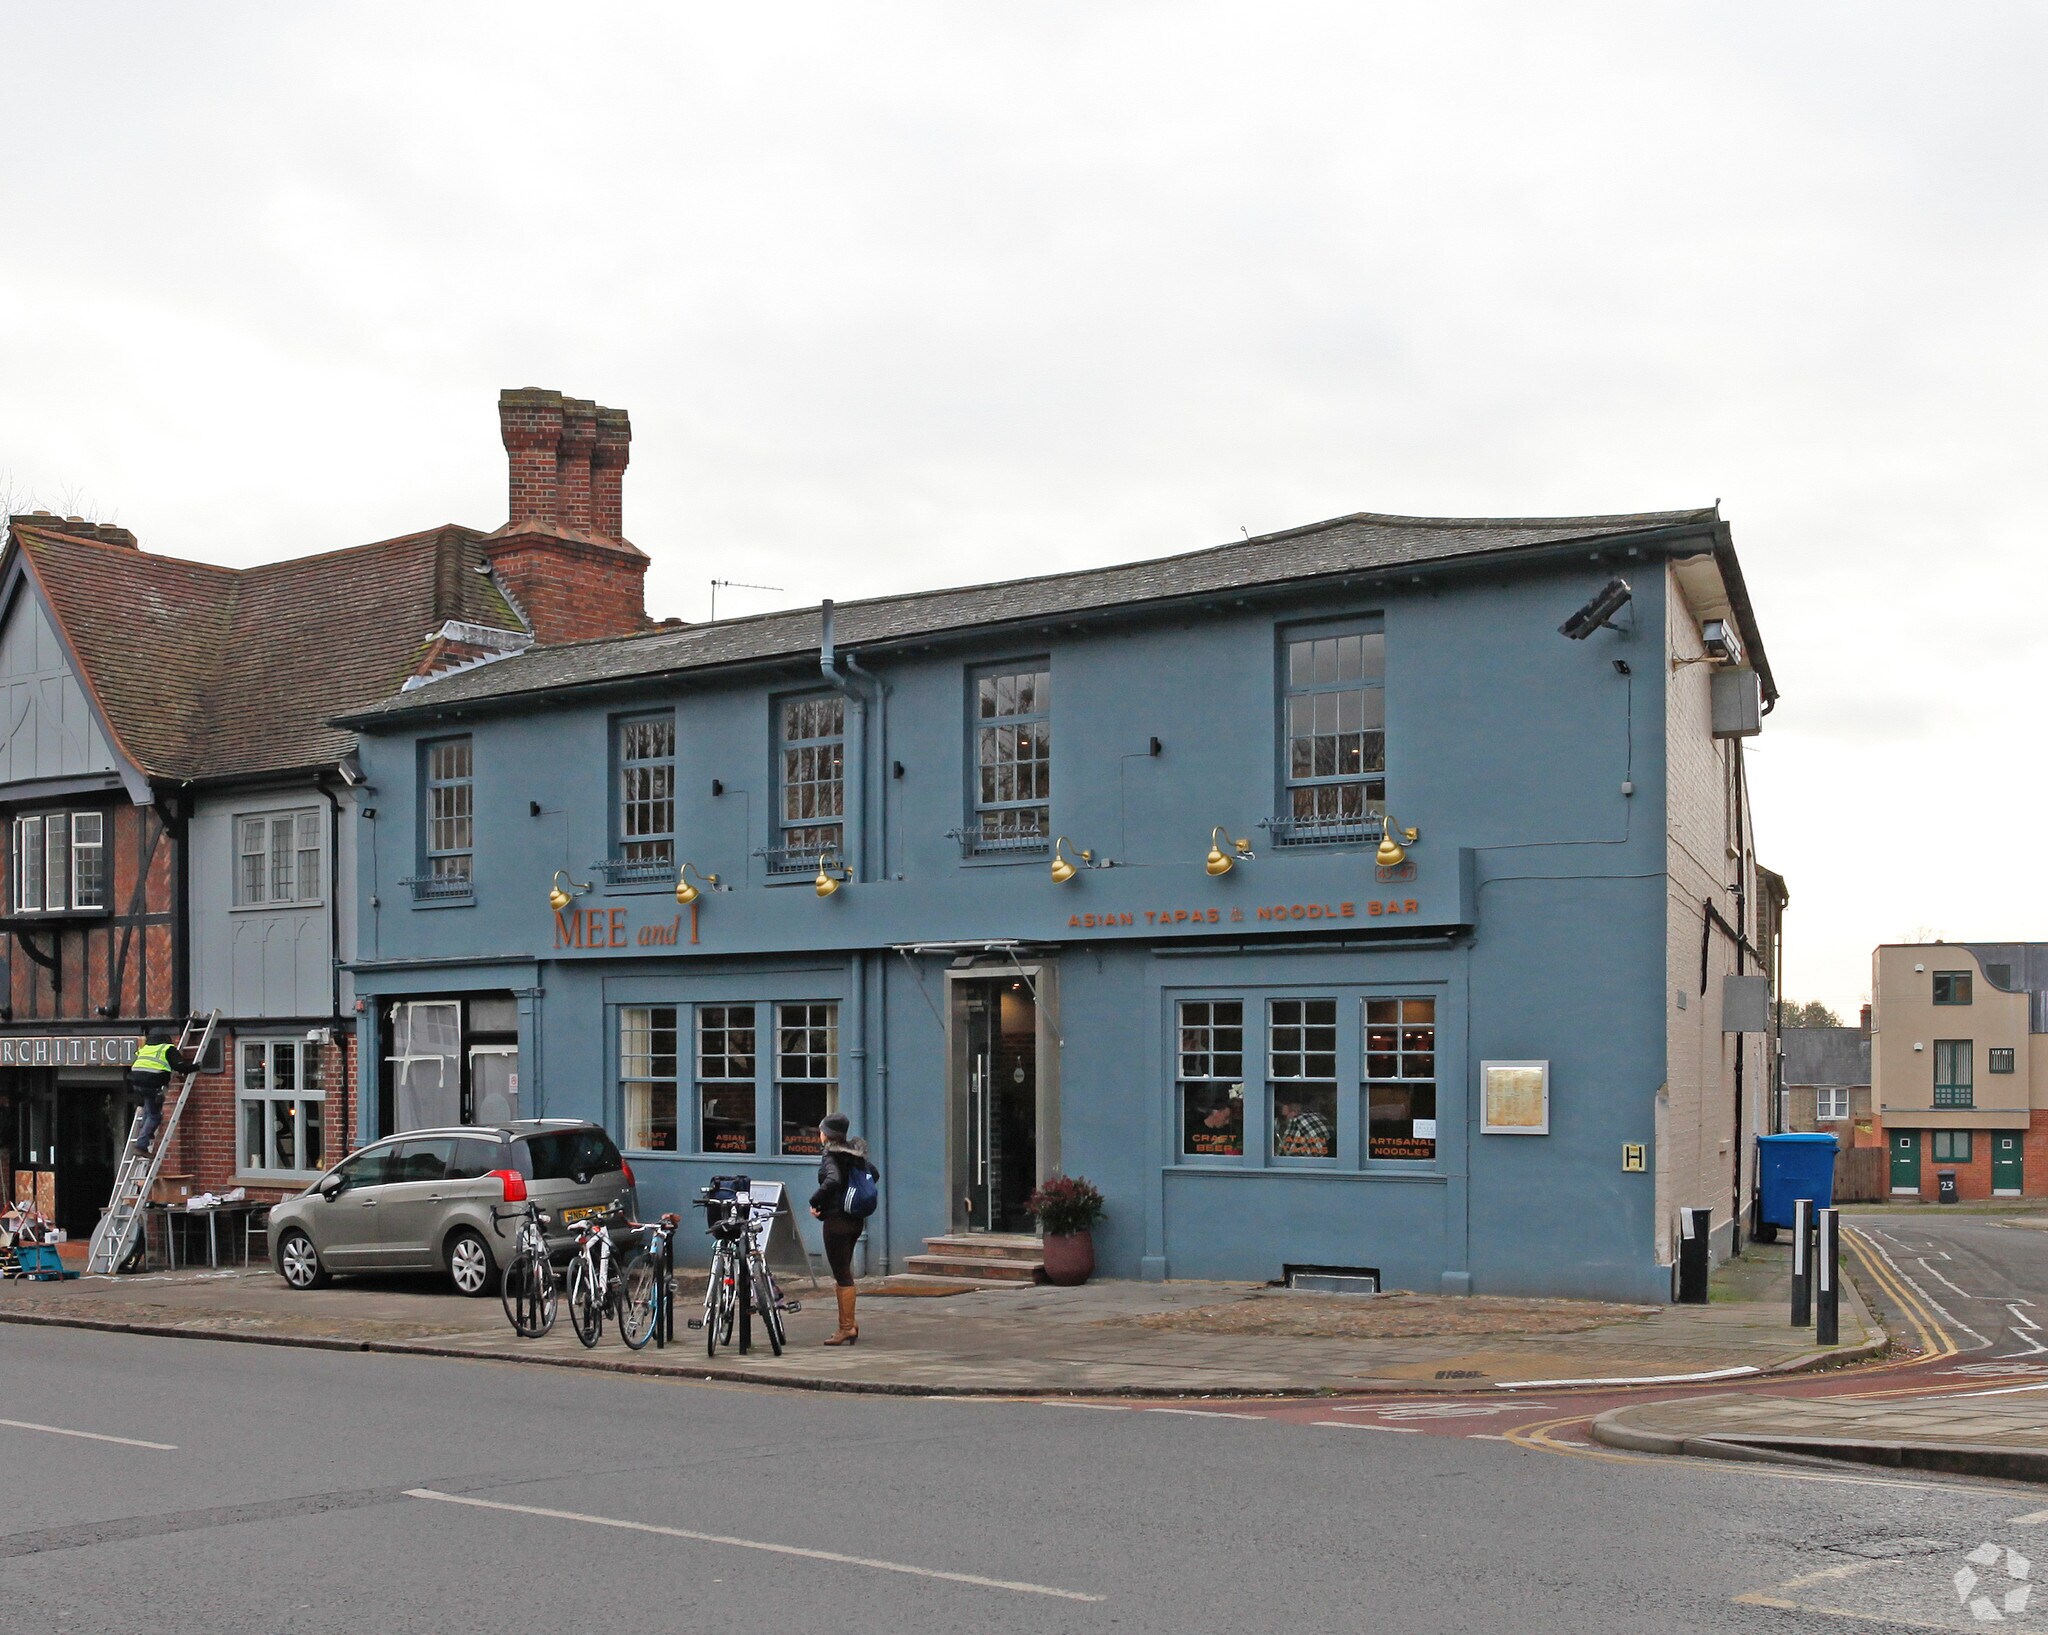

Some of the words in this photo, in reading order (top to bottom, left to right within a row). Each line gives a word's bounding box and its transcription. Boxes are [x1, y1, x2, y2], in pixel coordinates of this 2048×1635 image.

[1068, 911, 1133, 928] ASIAN
[1143, 907, 1219, 924] TAPAS
[1257, 902, 1356, 921] NOODLE
[1368, 898, 1418, 916] BAR
[552, 907, 628, 949] MEE
[637, 914, 682, 946] and
[688, 903, 702, 945] I
[3, 1040, 135, 1062] RCHITECT
[715, 1133, 746, 1141] ASIAN
[1191, 1134, 1236, 1142] CRAFT
[1369, 1137, 1435, 1147] ARTISANAL
[787, 1142, 820, 1151] NOODL
[1195, 1144, 1232, 1152] BEER
[1374, 1147, 1430, 1157] NOODLES
[1626, 1146, 1642, 1167] H
[1940, 1181, 1954, 1191] 23
